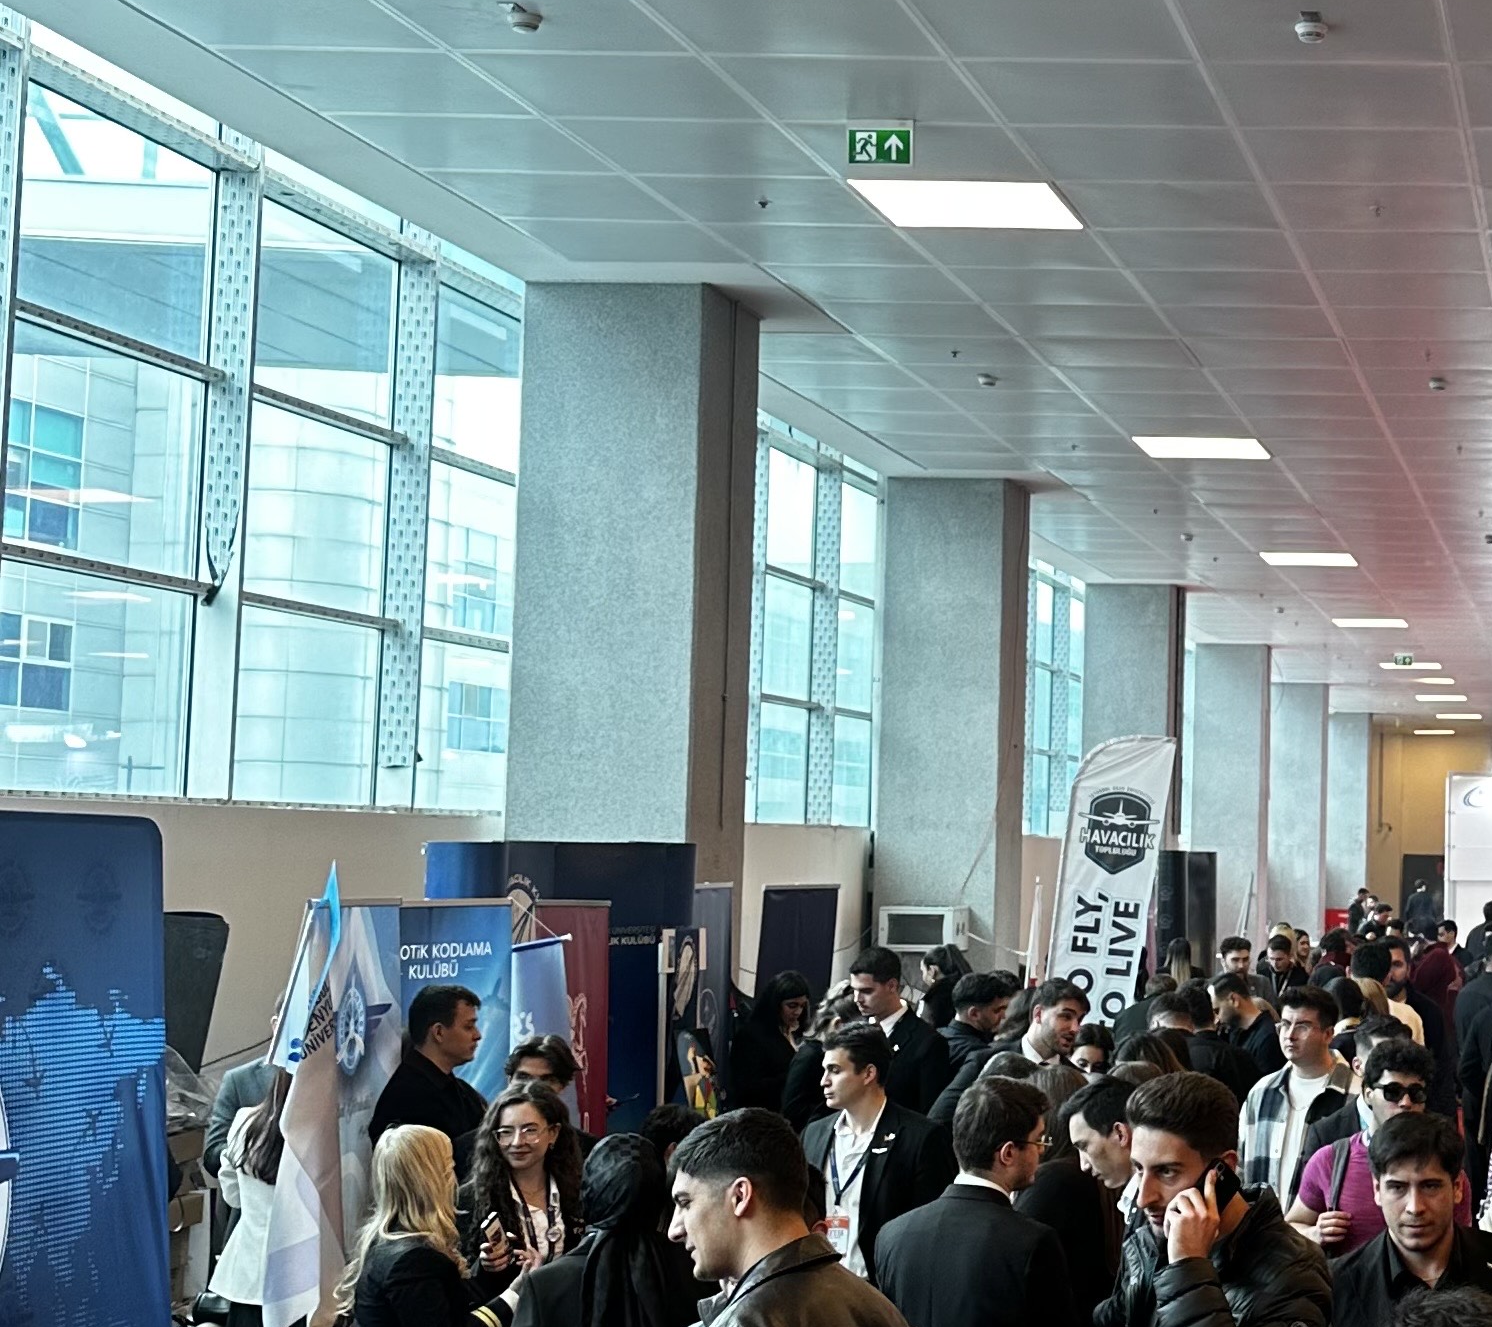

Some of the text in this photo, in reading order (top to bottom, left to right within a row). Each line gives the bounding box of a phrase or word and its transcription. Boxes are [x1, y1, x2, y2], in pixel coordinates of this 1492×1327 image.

[1079, 826, 1156, 849] HAVACILIK
[1071, 892, 1109, 954] FLY,
[432, 941, 493, 958] KODLAMA
[1105, 901, 1141, 978] LIVE
[408, 959, 459, 980] KULÜBÜ
